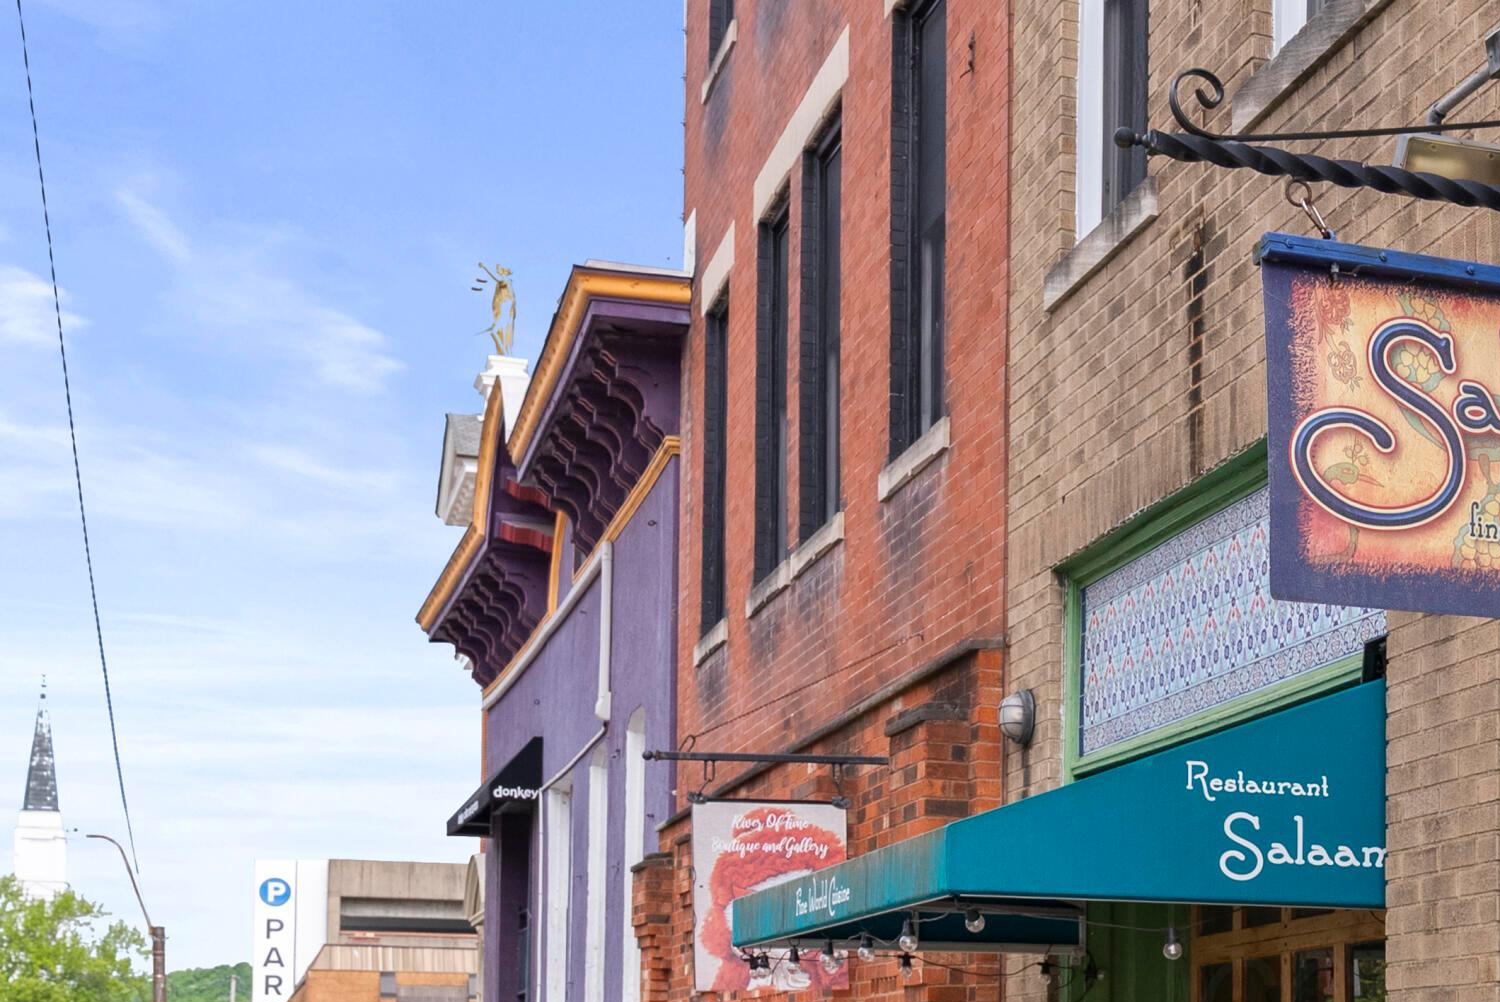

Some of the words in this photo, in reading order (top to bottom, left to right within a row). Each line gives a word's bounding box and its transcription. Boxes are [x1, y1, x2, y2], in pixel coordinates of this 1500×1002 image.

[493, 785, 539, 799] donkey
[1186, 760, 1329, 801] Restaurant
[731, 814, 764, 832] River
[711, 836, 760, 858] Boutique
[762, 837, 786, 853] and
[785, 836, 828, 859] Gallery
[796, 887, 808, 917] Fine
[808, 876, 828, 913] World
[828, 875, 850, 917] Cuisine
